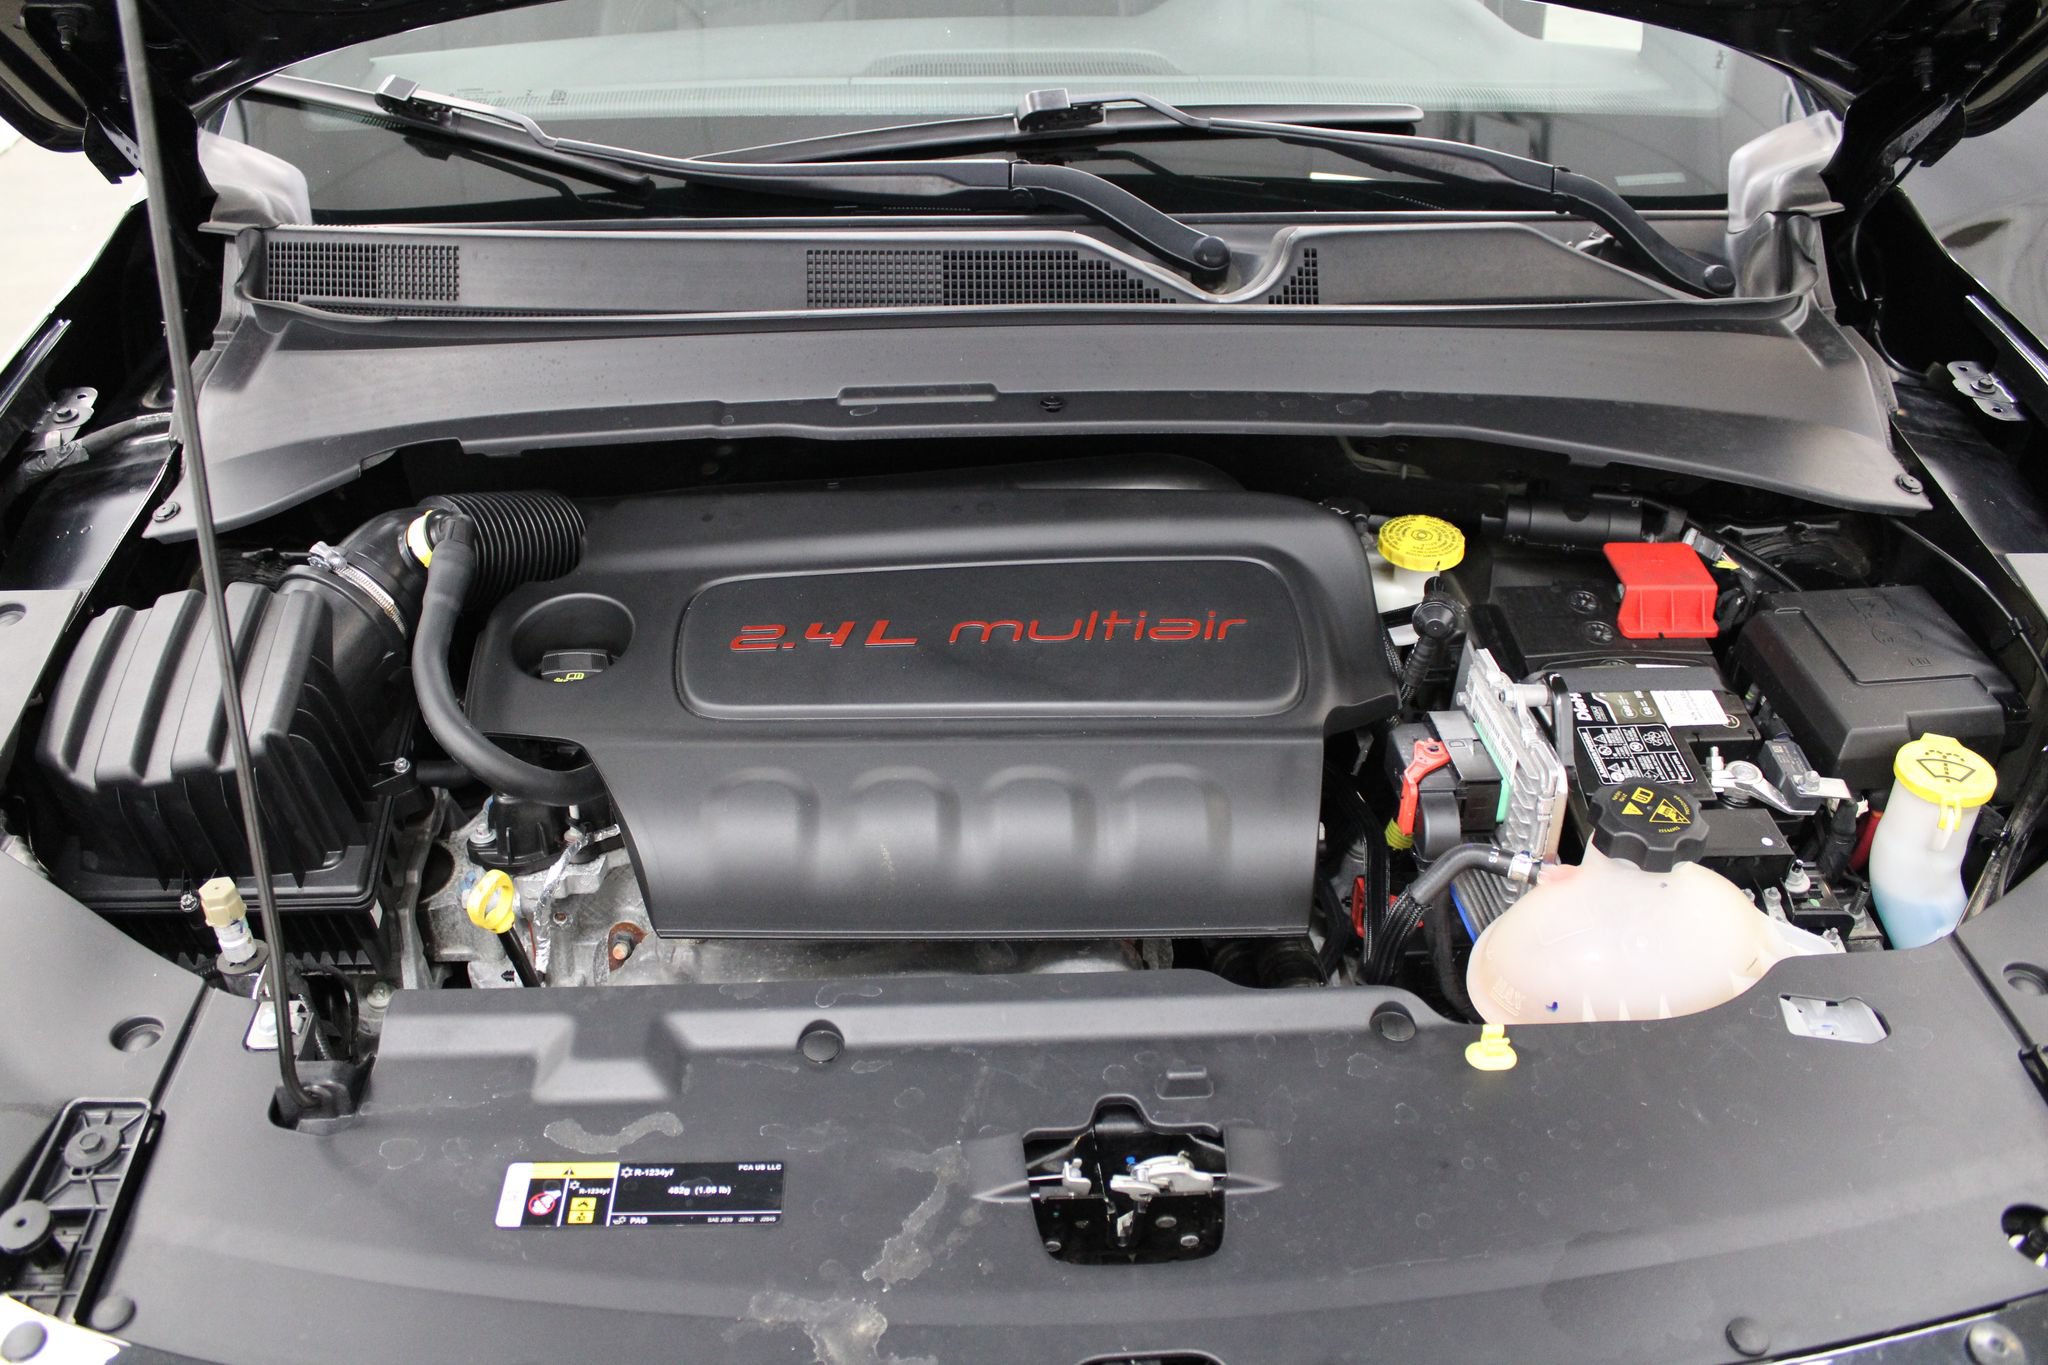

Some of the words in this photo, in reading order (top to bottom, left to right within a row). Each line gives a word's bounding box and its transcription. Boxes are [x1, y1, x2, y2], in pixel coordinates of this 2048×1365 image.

[948, 610, 1247, 643] multiair
[1569, 692, 1592, 721] DieH
[738, 1163, 754, 1171] FCA
[767, 1163, 782, 1171] LLC
[634, 1168, 674, 1179] R-1234yf
[579, 1187, 611, 1196] R-1234yf
[719, 1184, 731, 1196] lb)
